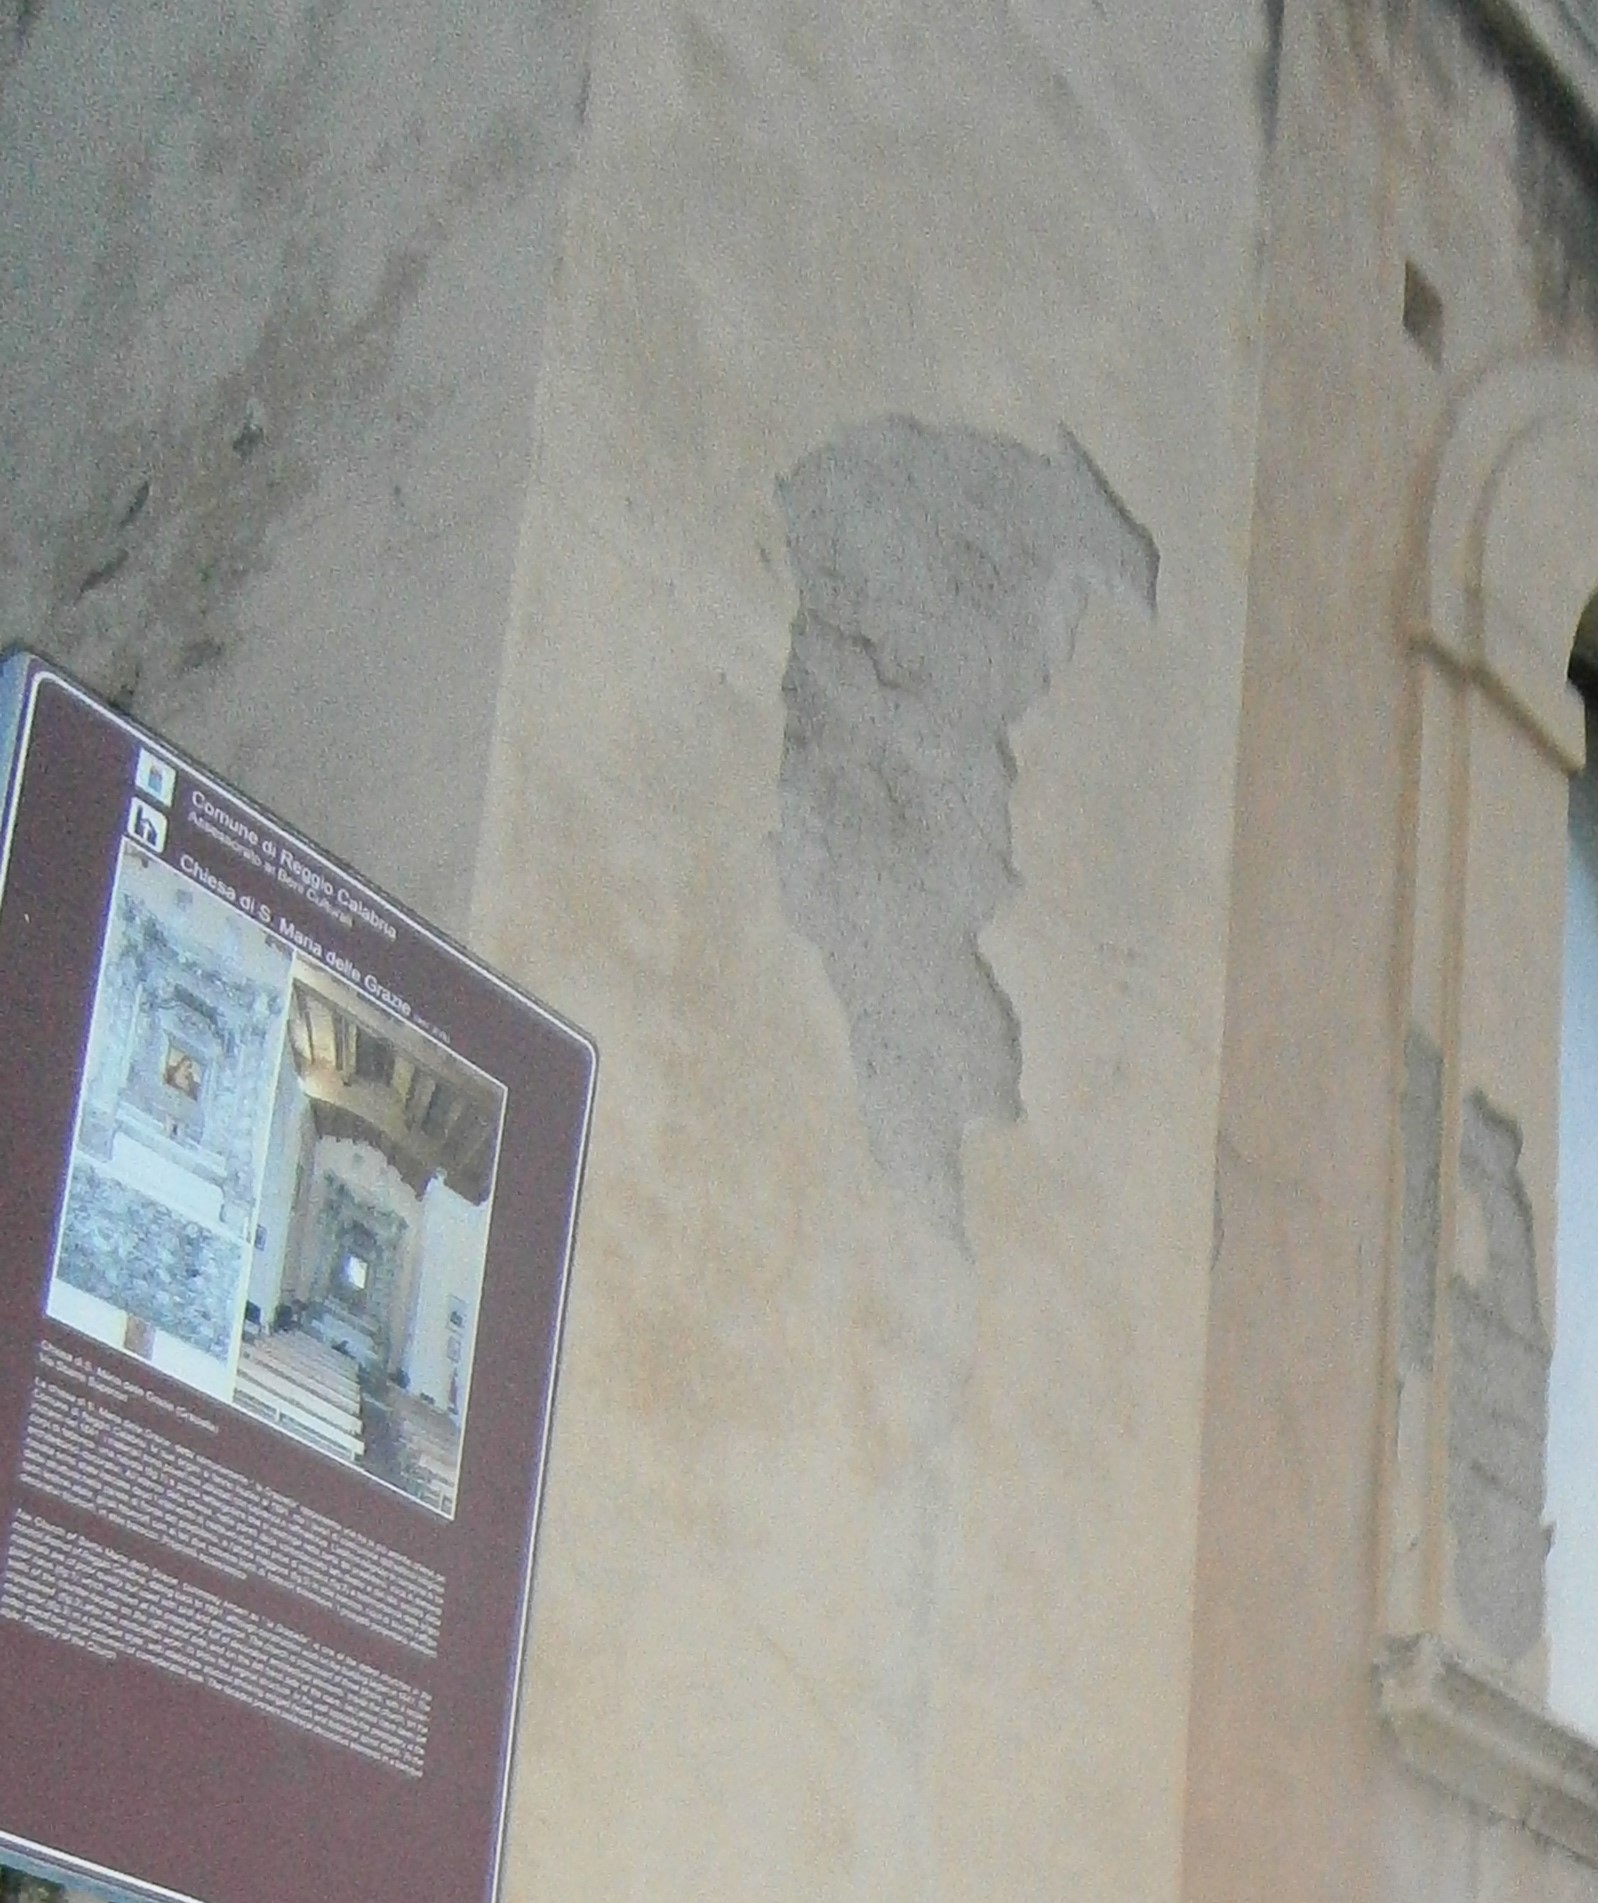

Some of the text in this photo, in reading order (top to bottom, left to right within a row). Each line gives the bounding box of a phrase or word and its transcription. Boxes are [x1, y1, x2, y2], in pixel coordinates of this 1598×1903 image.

[178, 850, 237, 903] Chiesa
[238, 889, 255, 914] di
[278, 915, 323, 959] Maria
[324, 946, 362, 984] delle
[363, 971, 412, 1018] Grazie
[190, 787, 398, 941] Comune di Reggio Calabria
